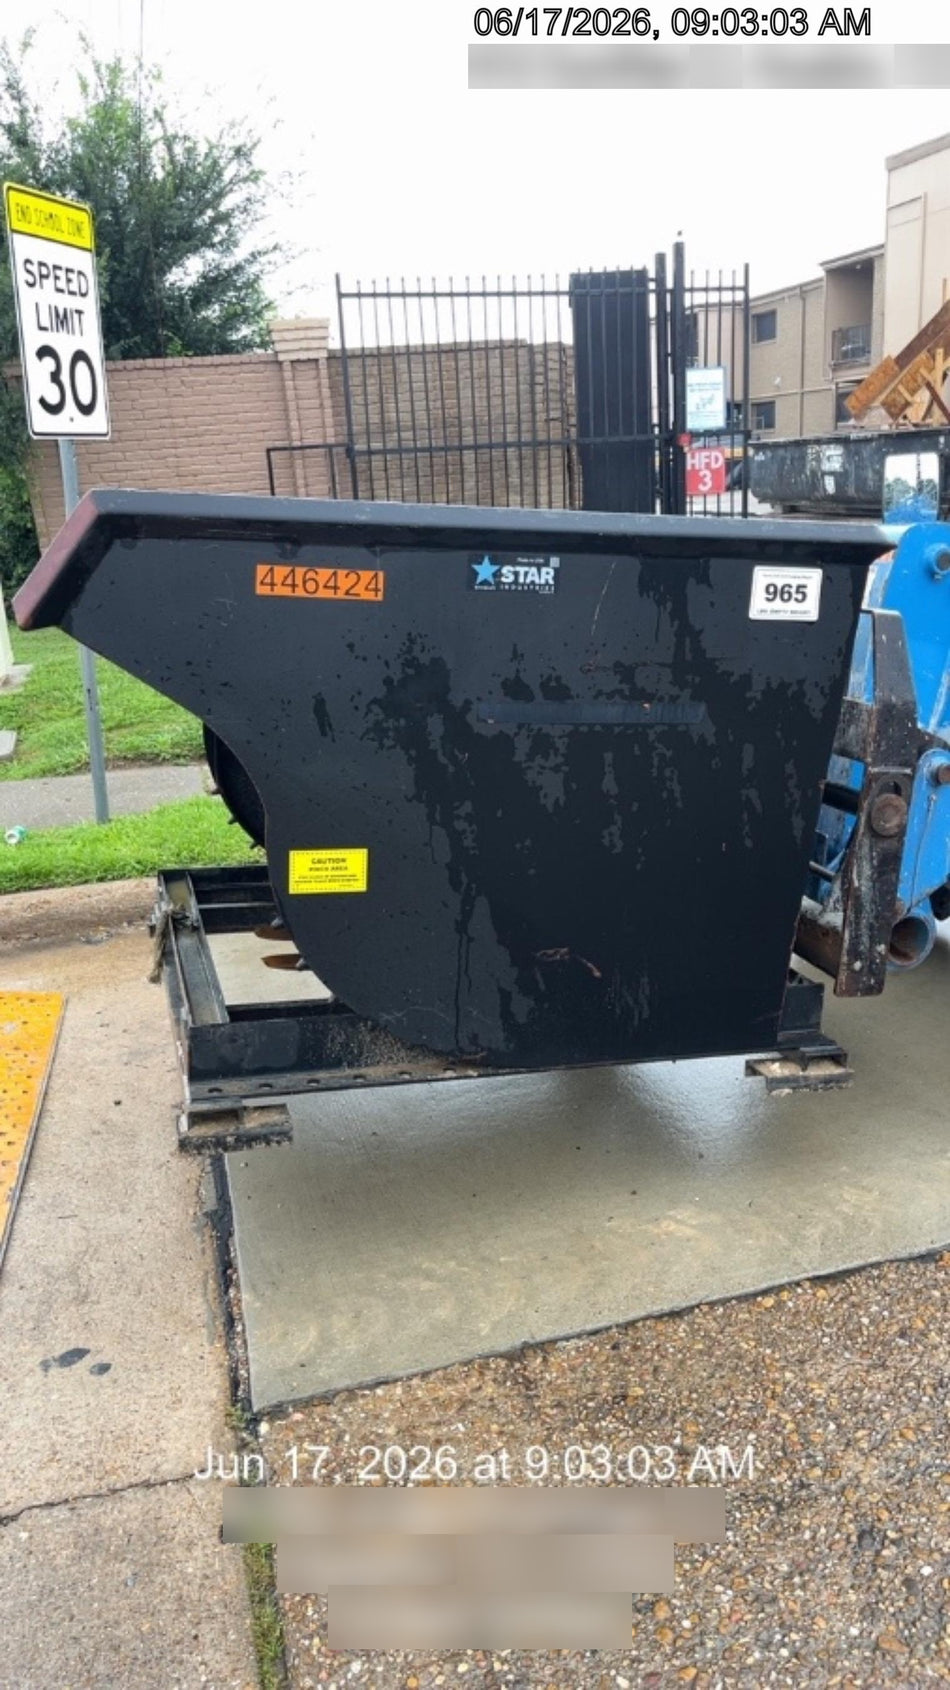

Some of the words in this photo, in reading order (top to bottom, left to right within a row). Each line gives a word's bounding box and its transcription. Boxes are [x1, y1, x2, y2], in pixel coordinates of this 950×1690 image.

[23, 258, 89, 298] SPEED
[35, 302, 85, 337] LIMIT
[35, 345, 97, 416] 30
[686, 450, 724, 470] HFD
[698, 470, 713, 492] 3
[260, 566, 382, 598] 446424
[500, 565, 555, 585] STAR
[765, 583, 808, 603] 965
[311, 857, 347, 865] CAUTION
